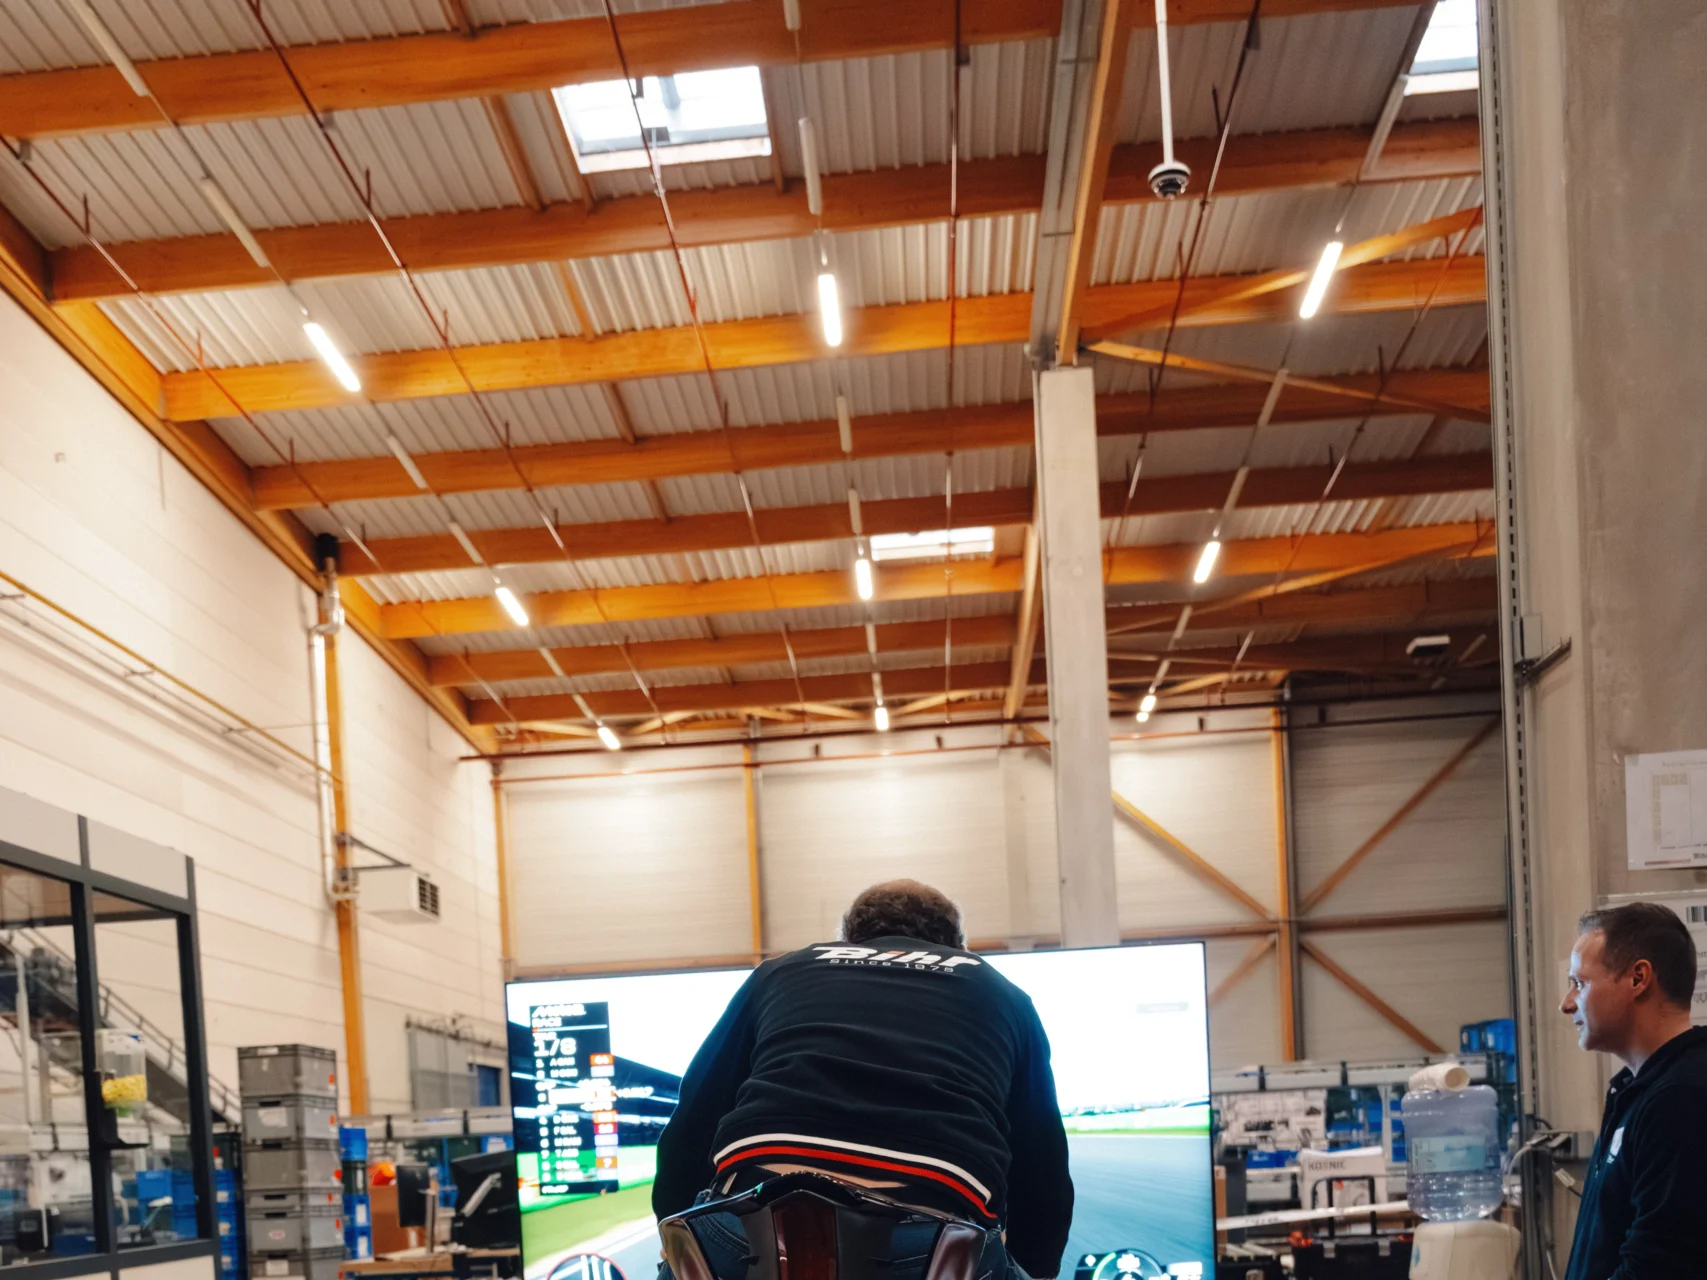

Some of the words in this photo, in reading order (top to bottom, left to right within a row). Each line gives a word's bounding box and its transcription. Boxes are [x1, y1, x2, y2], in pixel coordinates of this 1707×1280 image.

[812, 946, 981, 967] Bihr
[903, 963, 954, 973] 1975
[533, 1037, 577, 1057] 1/8
